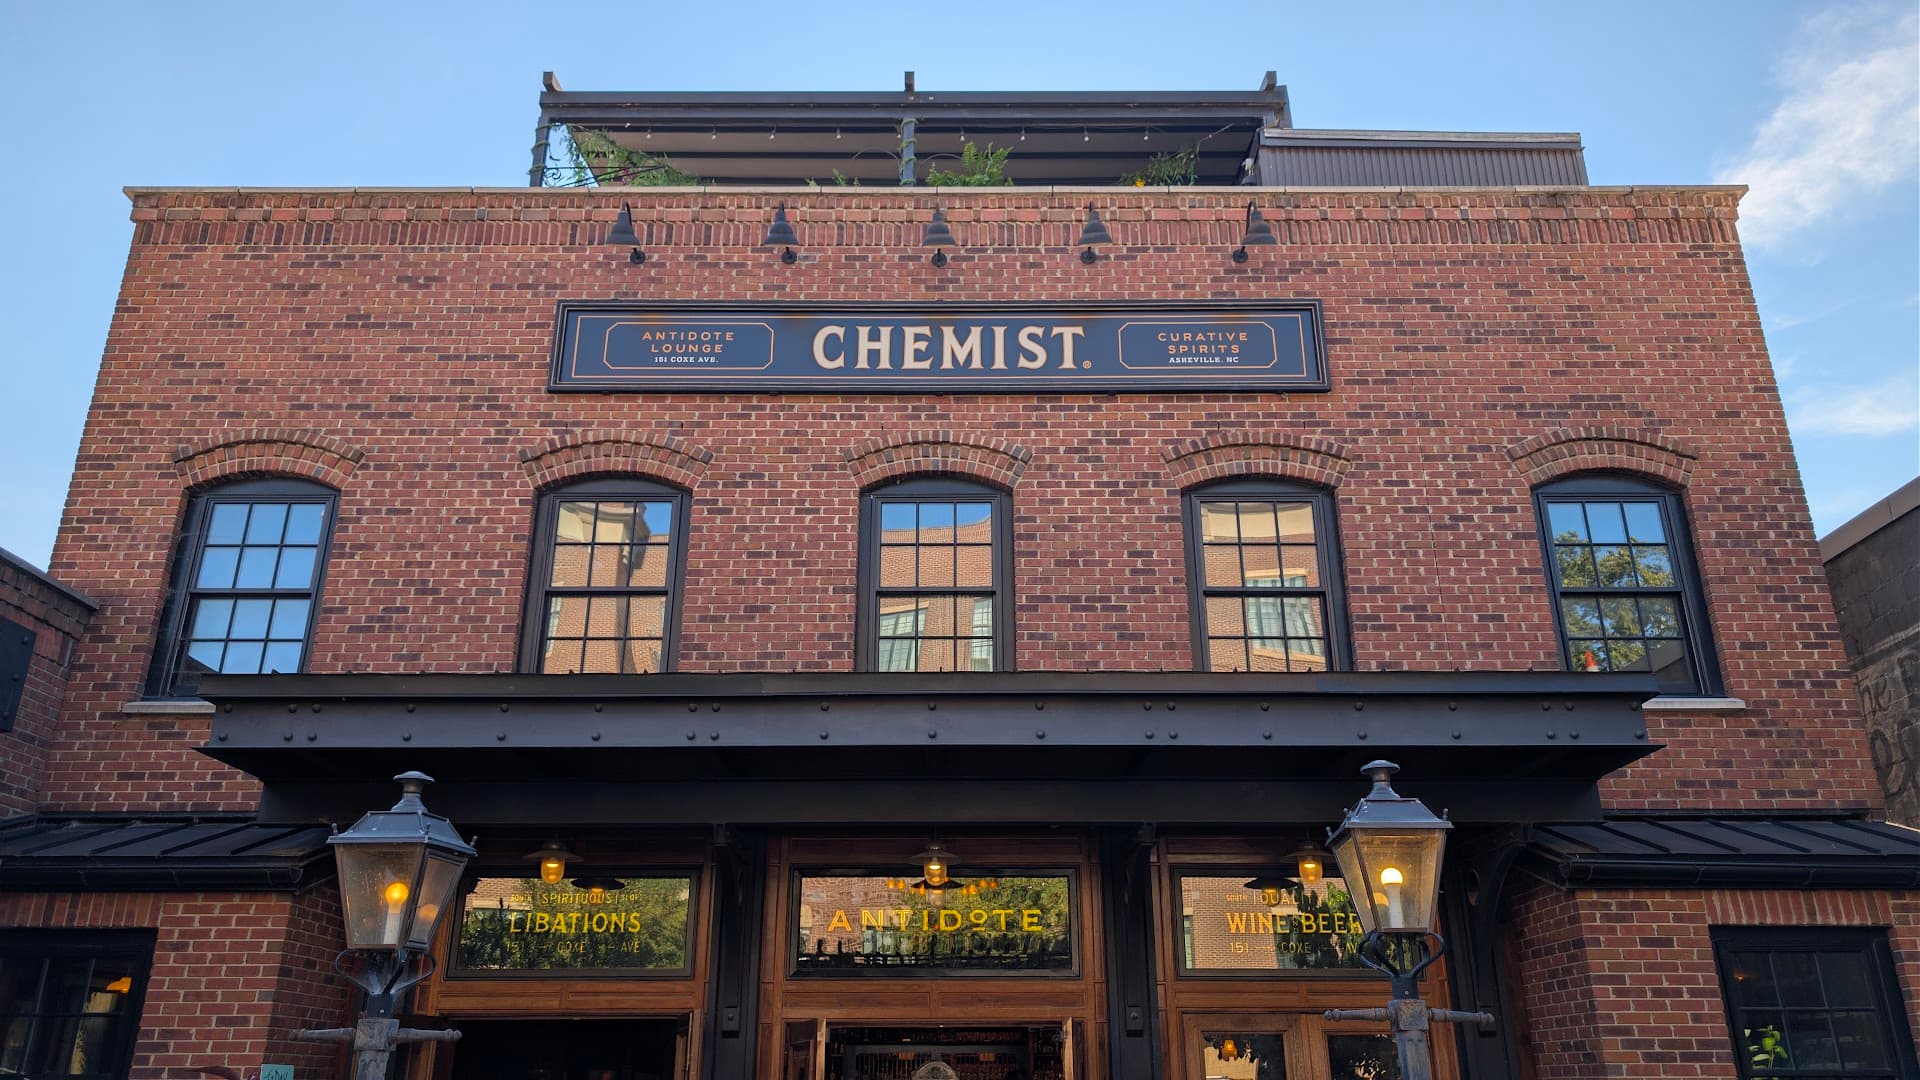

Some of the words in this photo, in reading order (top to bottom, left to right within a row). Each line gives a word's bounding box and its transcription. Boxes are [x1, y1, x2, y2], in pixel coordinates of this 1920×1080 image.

[642, 331, 734, 341] ANTIDOTE
[1158, 332, 1248, 342] CURATIVE
[651, 344, 723, 353] LOUNGE
[1168, 345, 1240, 354] SPIRITS
[541, 893, 612, 904] SPIRITUOUS
[1260, 893, 1325, 905] QUALITY
[510, 912, 641, 933] LIBATIONS
[827, 909, 1043, 932] ANTIDOTE
[1226, 912, 1290, 934] WINE
[620, 941, 640, 952] AVE
[1230, 942, 1249, 953] 151
[1281, 942, 1311, 953] COXE
